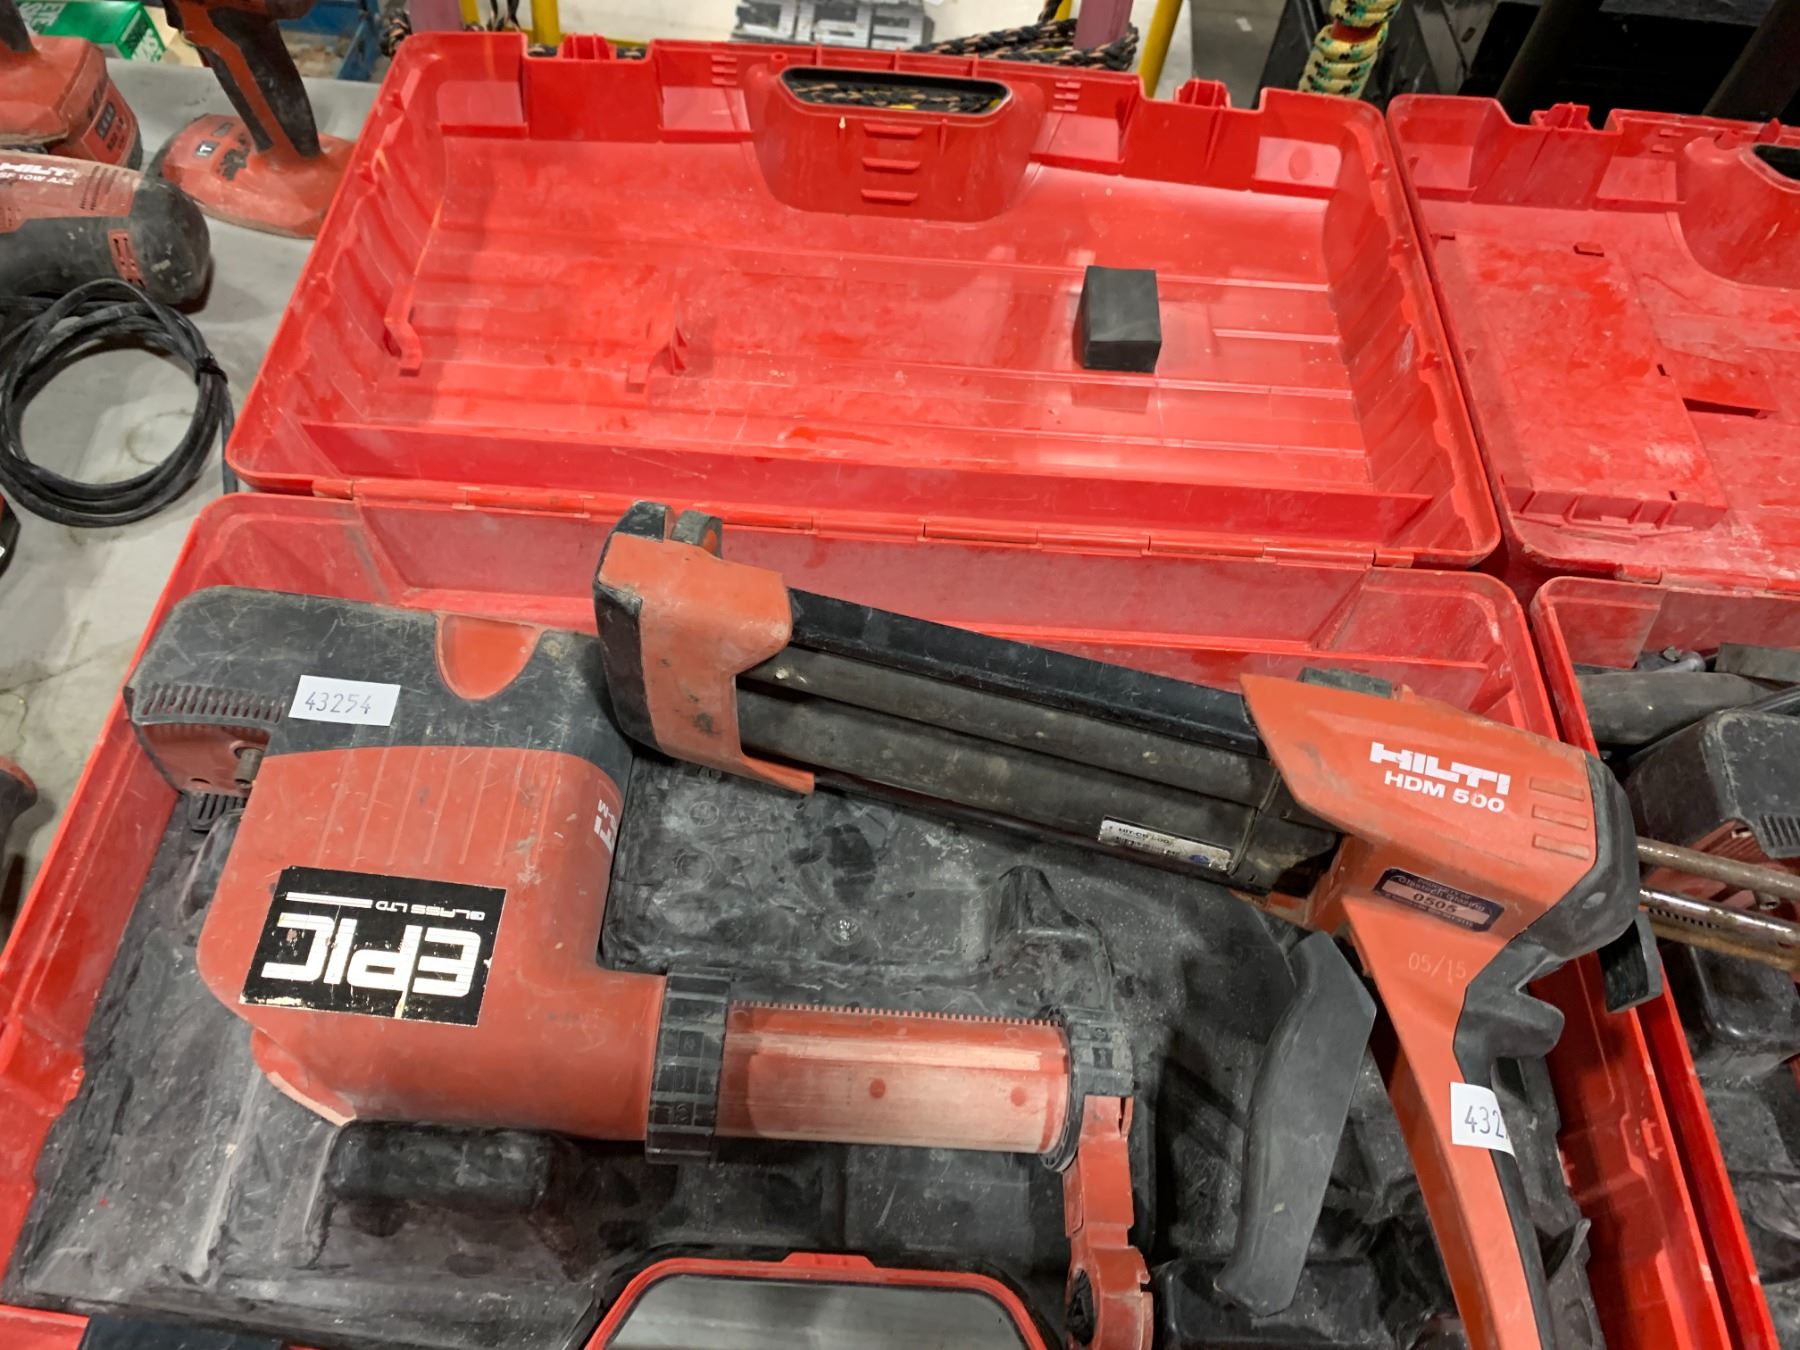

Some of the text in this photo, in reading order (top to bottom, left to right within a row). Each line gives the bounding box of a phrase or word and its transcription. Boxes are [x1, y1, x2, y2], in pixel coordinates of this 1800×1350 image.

[304, 690, 373, 715] 43254
[1369, 741, 1511, 796] HILTI
[1384, 770, 1505, 813] HDM 500
[375, 900, 486, 922] GLASS LTD
[1413, 893, 1457, 914] 0505
[260, 911, 483, 998] EPIC
[1408, 951, 1467, 984] 05/15
[1464, 1105, 1509, 1140] 432
